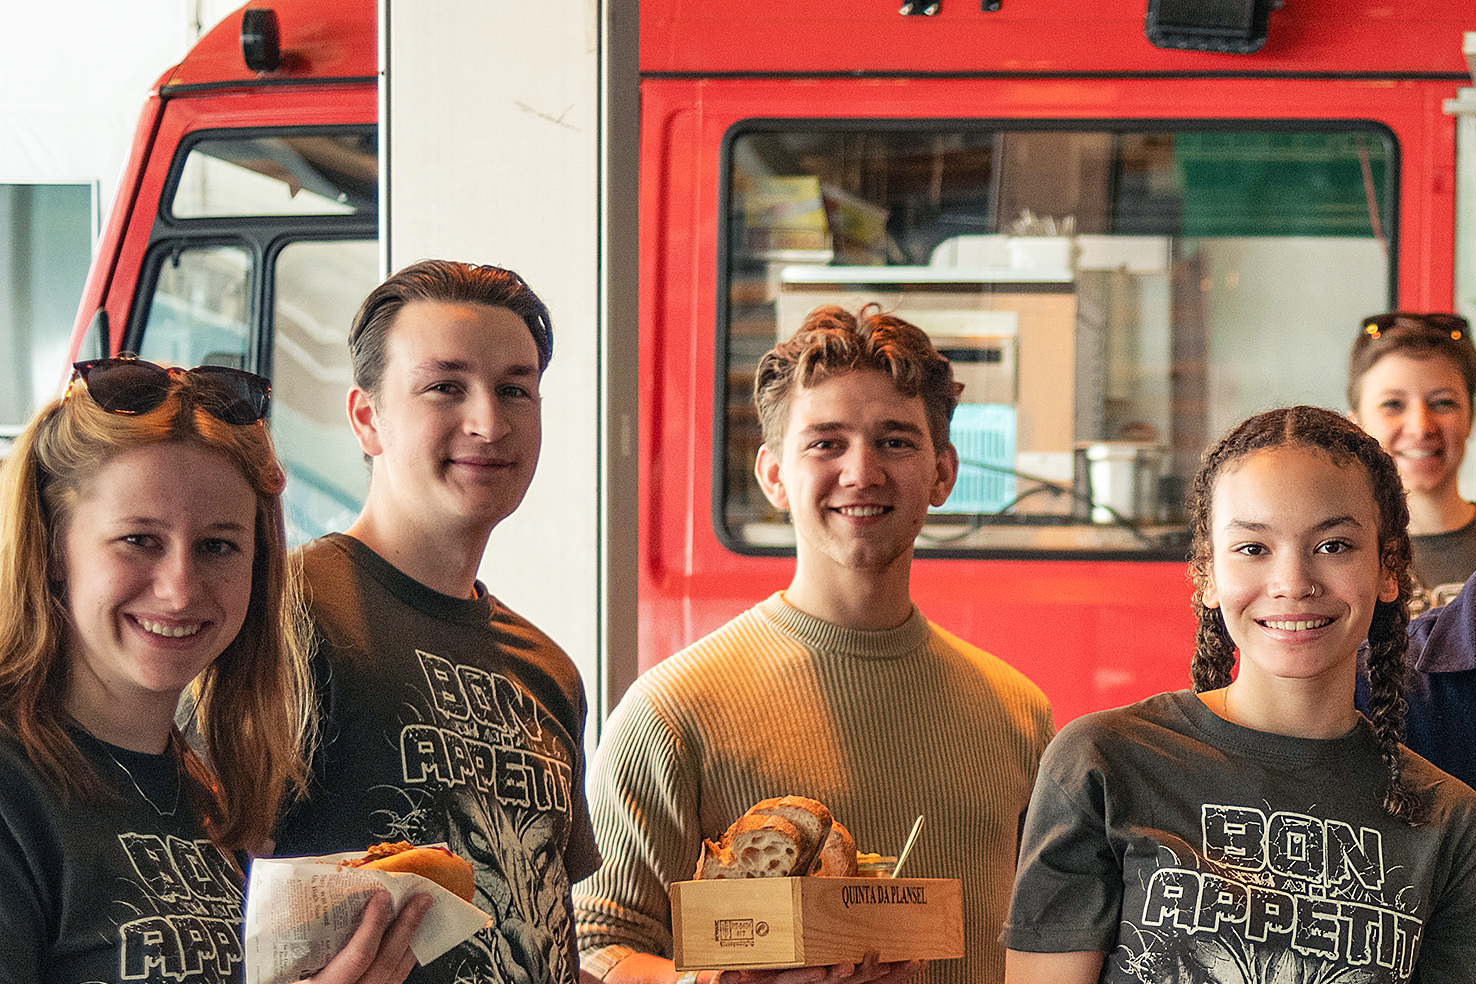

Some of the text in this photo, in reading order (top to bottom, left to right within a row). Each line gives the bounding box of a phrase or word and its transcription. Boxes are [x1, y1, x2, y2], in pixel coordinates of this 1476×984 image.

[415, 649, 542, 741] BON
[1202, 804, 1384, 890] BON
[842, 886, 927, 908] QUINTA DA PLANSEL
